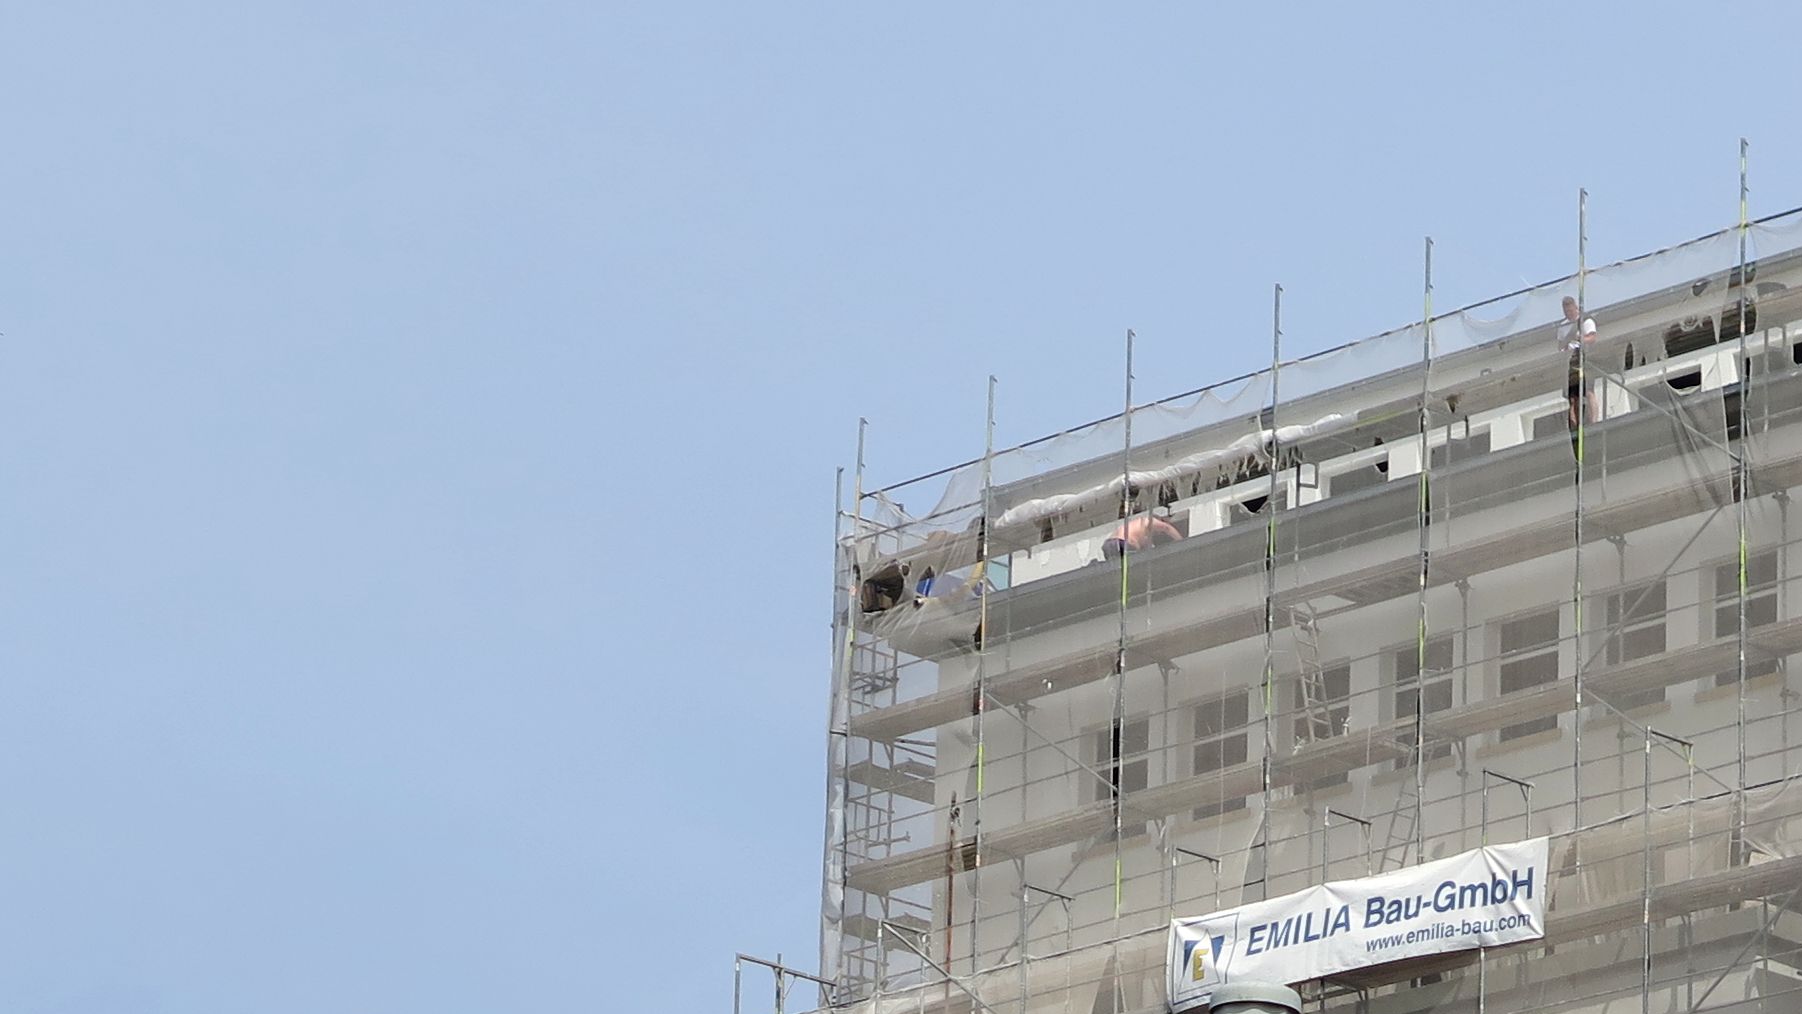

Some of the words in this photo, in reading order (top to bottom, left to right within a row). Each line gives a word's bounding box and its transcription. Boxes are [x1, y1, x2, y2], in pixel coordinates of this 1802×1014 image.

[1246, 904, 1351, 956] EMILIA
[1364, 867, 1534, 928] Bau-GmbH
[1366, 914, 1531, 952] www.emilia-bau.com
